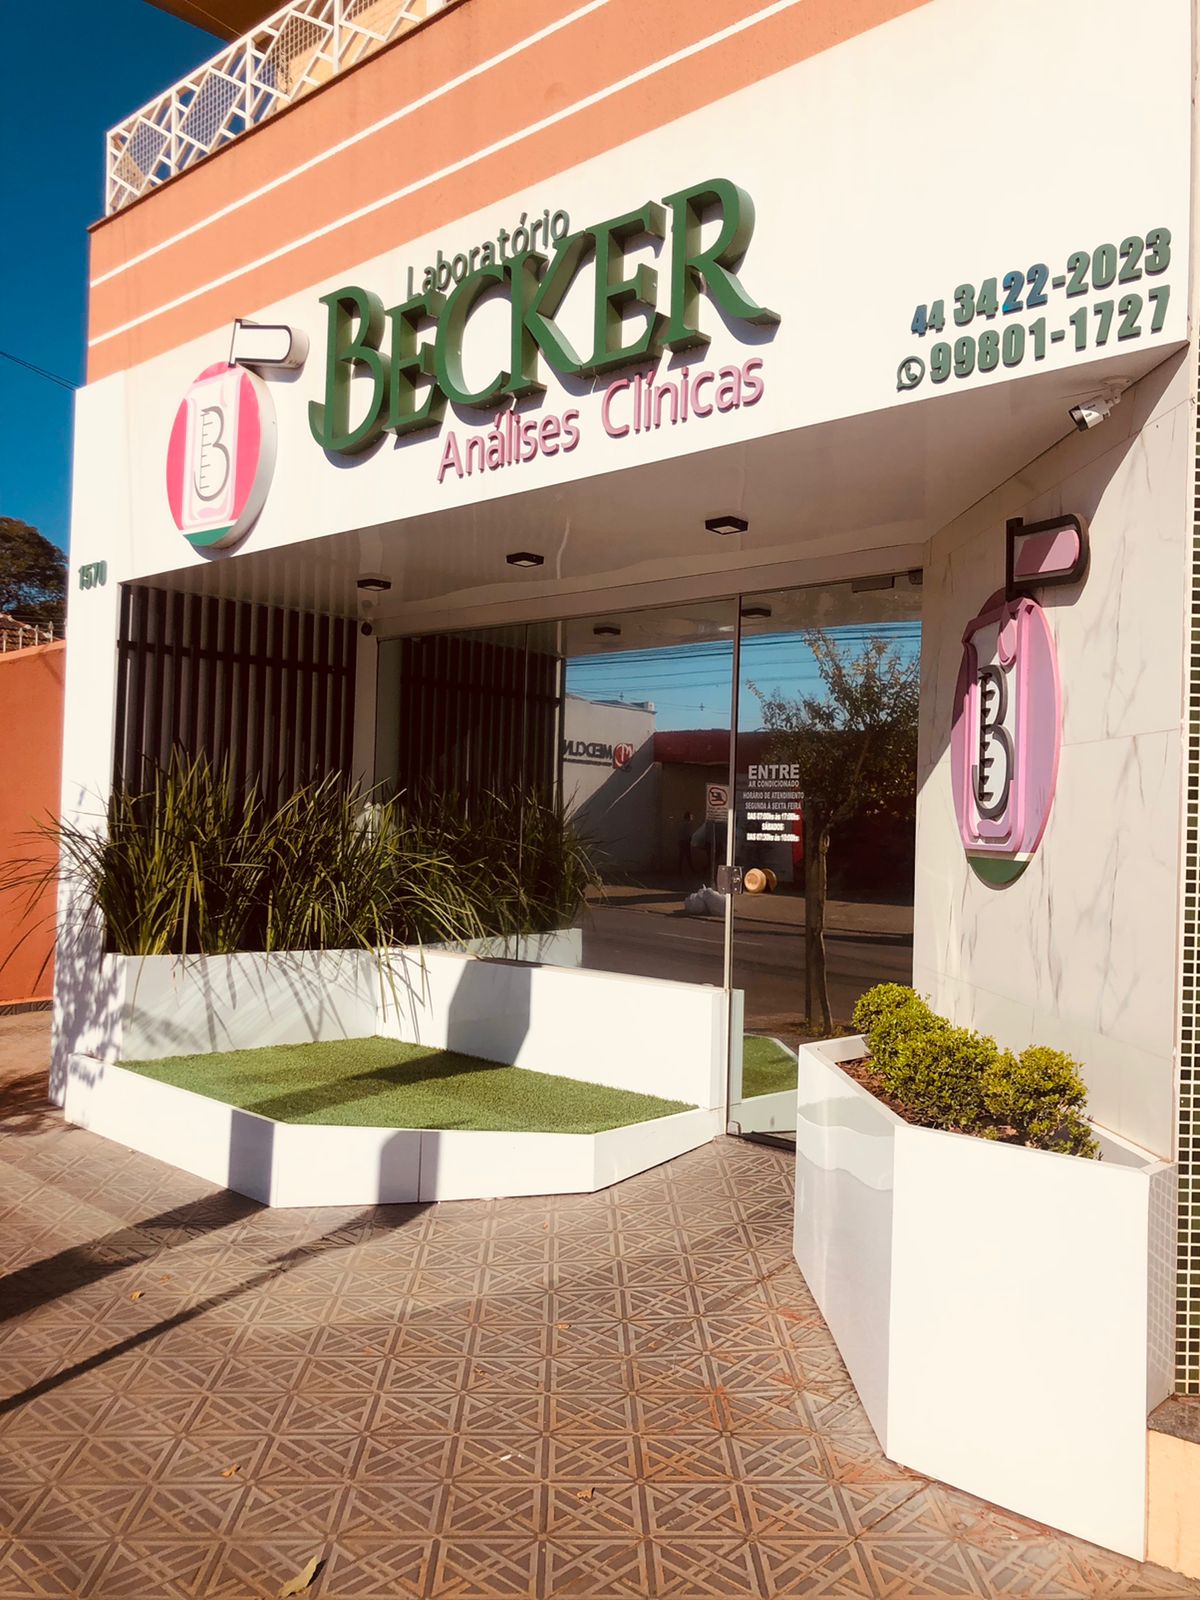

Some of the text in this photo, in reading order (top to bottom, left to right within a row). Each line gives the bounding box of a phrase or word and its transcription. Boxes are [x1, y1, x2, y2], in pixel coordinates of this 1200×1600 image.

[406, 208, 571, 300] Laboratório
[911, 227, 1172, 336] 44 3422-2023
[307, 177, 781, 455] BECKER
[929, 284, 1171, 384] 99801-1727
[437, 357, 765, 483] Análises Clínicas
[78, 560, 107, 590] 1570
[748, 764, 799, 779] ENTRE
[748, 780, 799, 788] AR CONDICIONADO
[764, 791, 771, 799] DE
[772, 791, 804, 800] ATENDIMENTO
[745, 802, 767, 810] SEGUNDA
[772, 802, 787, 810] SEXTA
[787, 802, 802, 810] FEIRA
